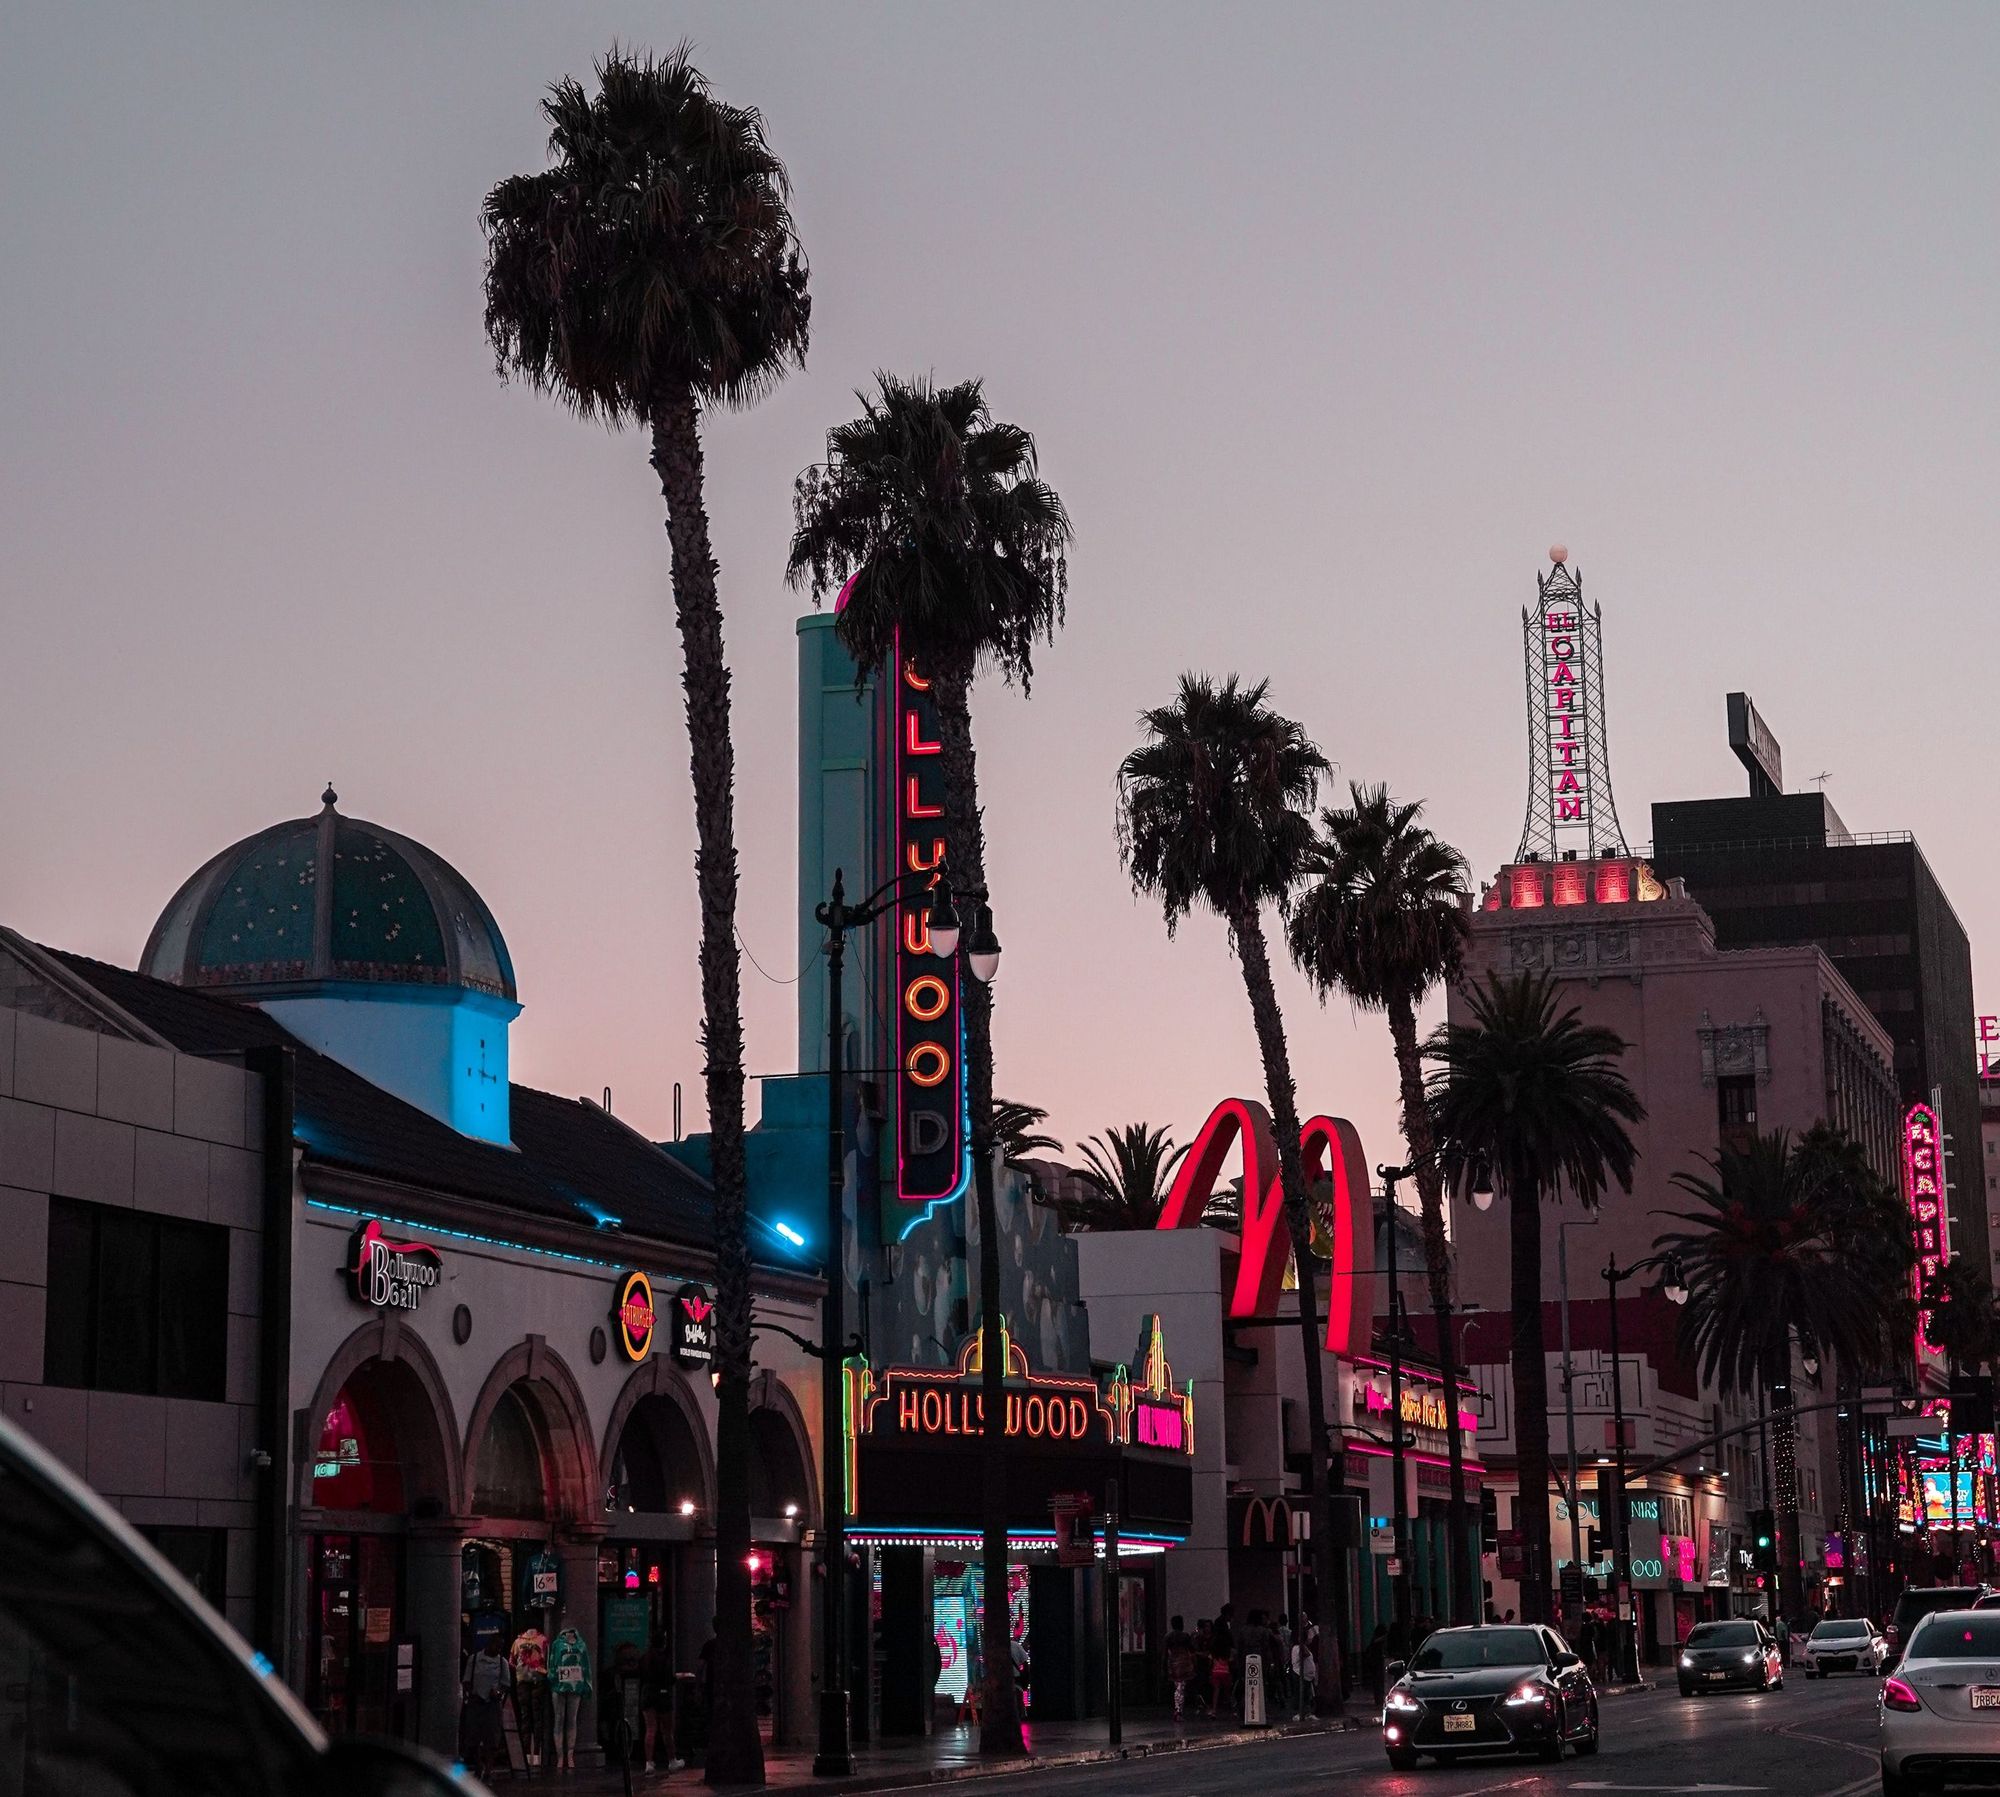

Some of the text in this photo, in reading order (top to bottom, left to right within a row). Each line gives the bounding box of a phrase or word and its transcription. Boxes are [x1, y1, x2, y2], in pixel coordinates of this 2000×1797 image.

[1546, 612, 1583, 820] EL CAPITAN
[1555, 1501, 1658, 1520] SOUNIRS
